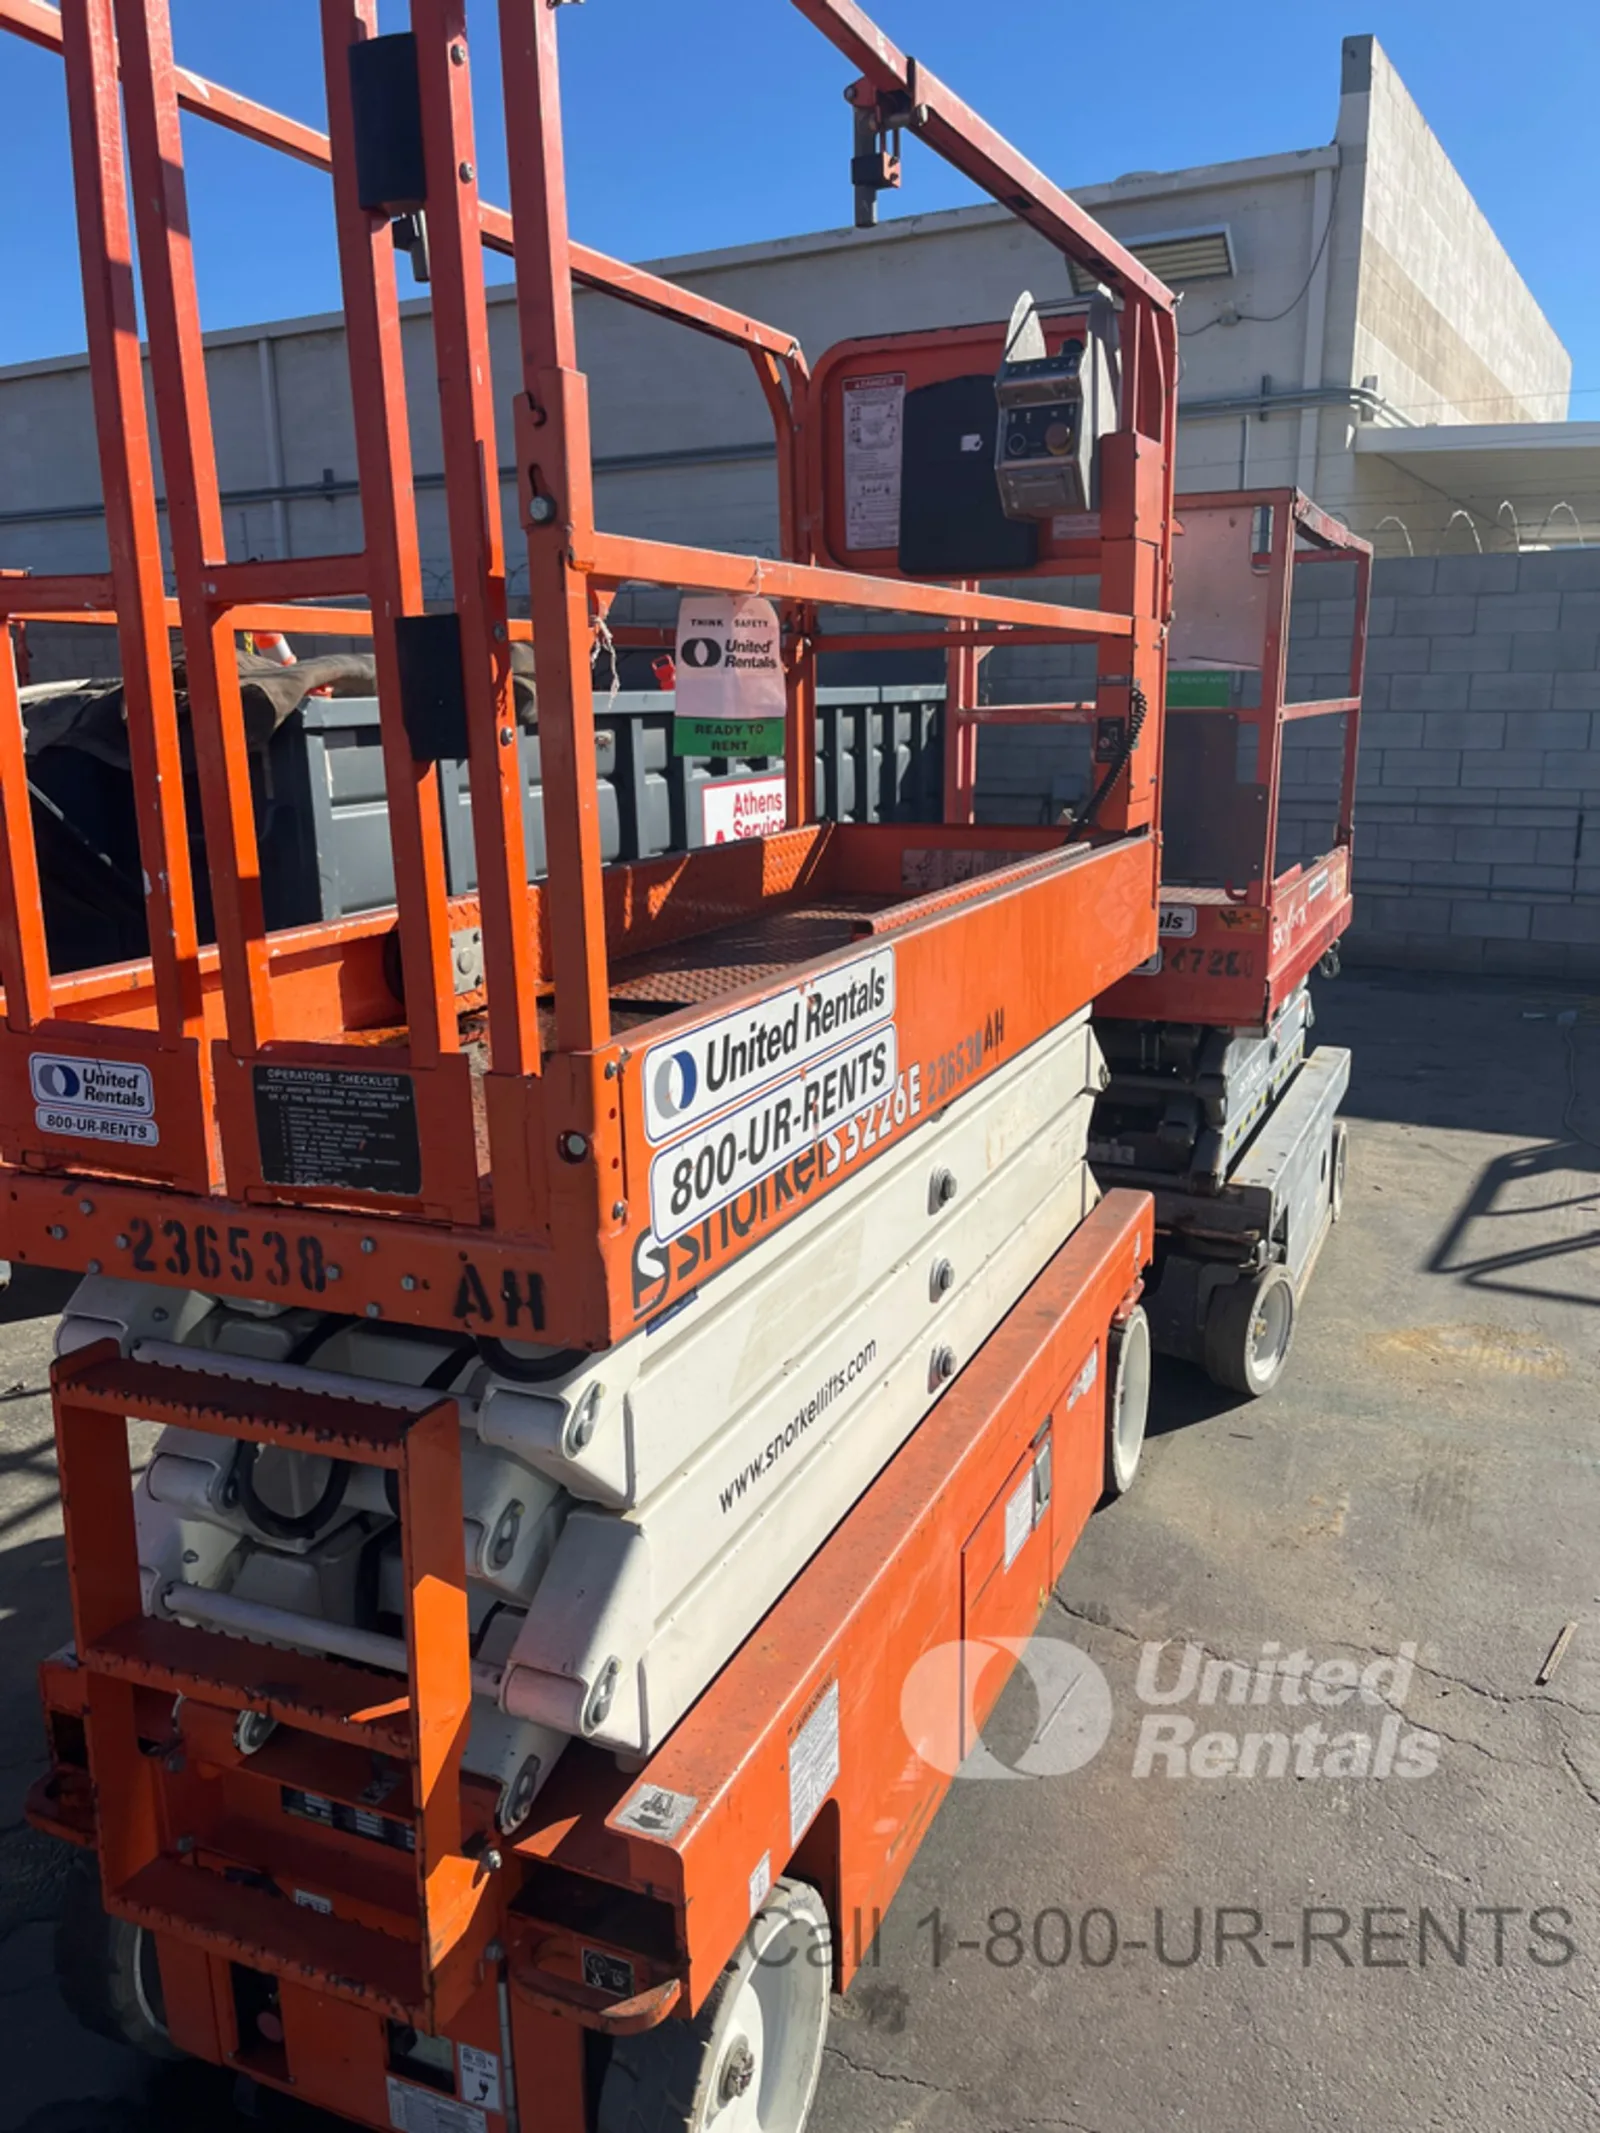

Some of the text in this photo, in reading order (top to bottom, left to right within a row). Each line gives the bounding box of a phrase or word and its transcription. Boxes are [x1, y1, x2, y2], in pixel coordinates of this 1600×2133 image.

[690, 618, 769, 628] THINK SAFETY
[725, 639, 774, 654] United
[724, 654, 778, 669] Rentals
[694, 723, 765, 735] READY TO
[711, 741, 749, 752] RENT
[733, 790, 783, 818] Athens
[706, 967, 885, 1093] United Rentals
[984, 1007, 1005, 1053] AH
[82, 1068, 139, 1090] United
[266, 1068, 400, 1087] OPERATORS CHECKLIST
[84, 1085, 146, 1108] Rentals
[46, 1113, 148, 1139] 800-UR-RENTS
[670, 1041, 887, 1216] 800-UR-RENTS
[453, 1262, 546, 1332] AH
[718, 1339, 877, 1514] www.snorkellifts.com
